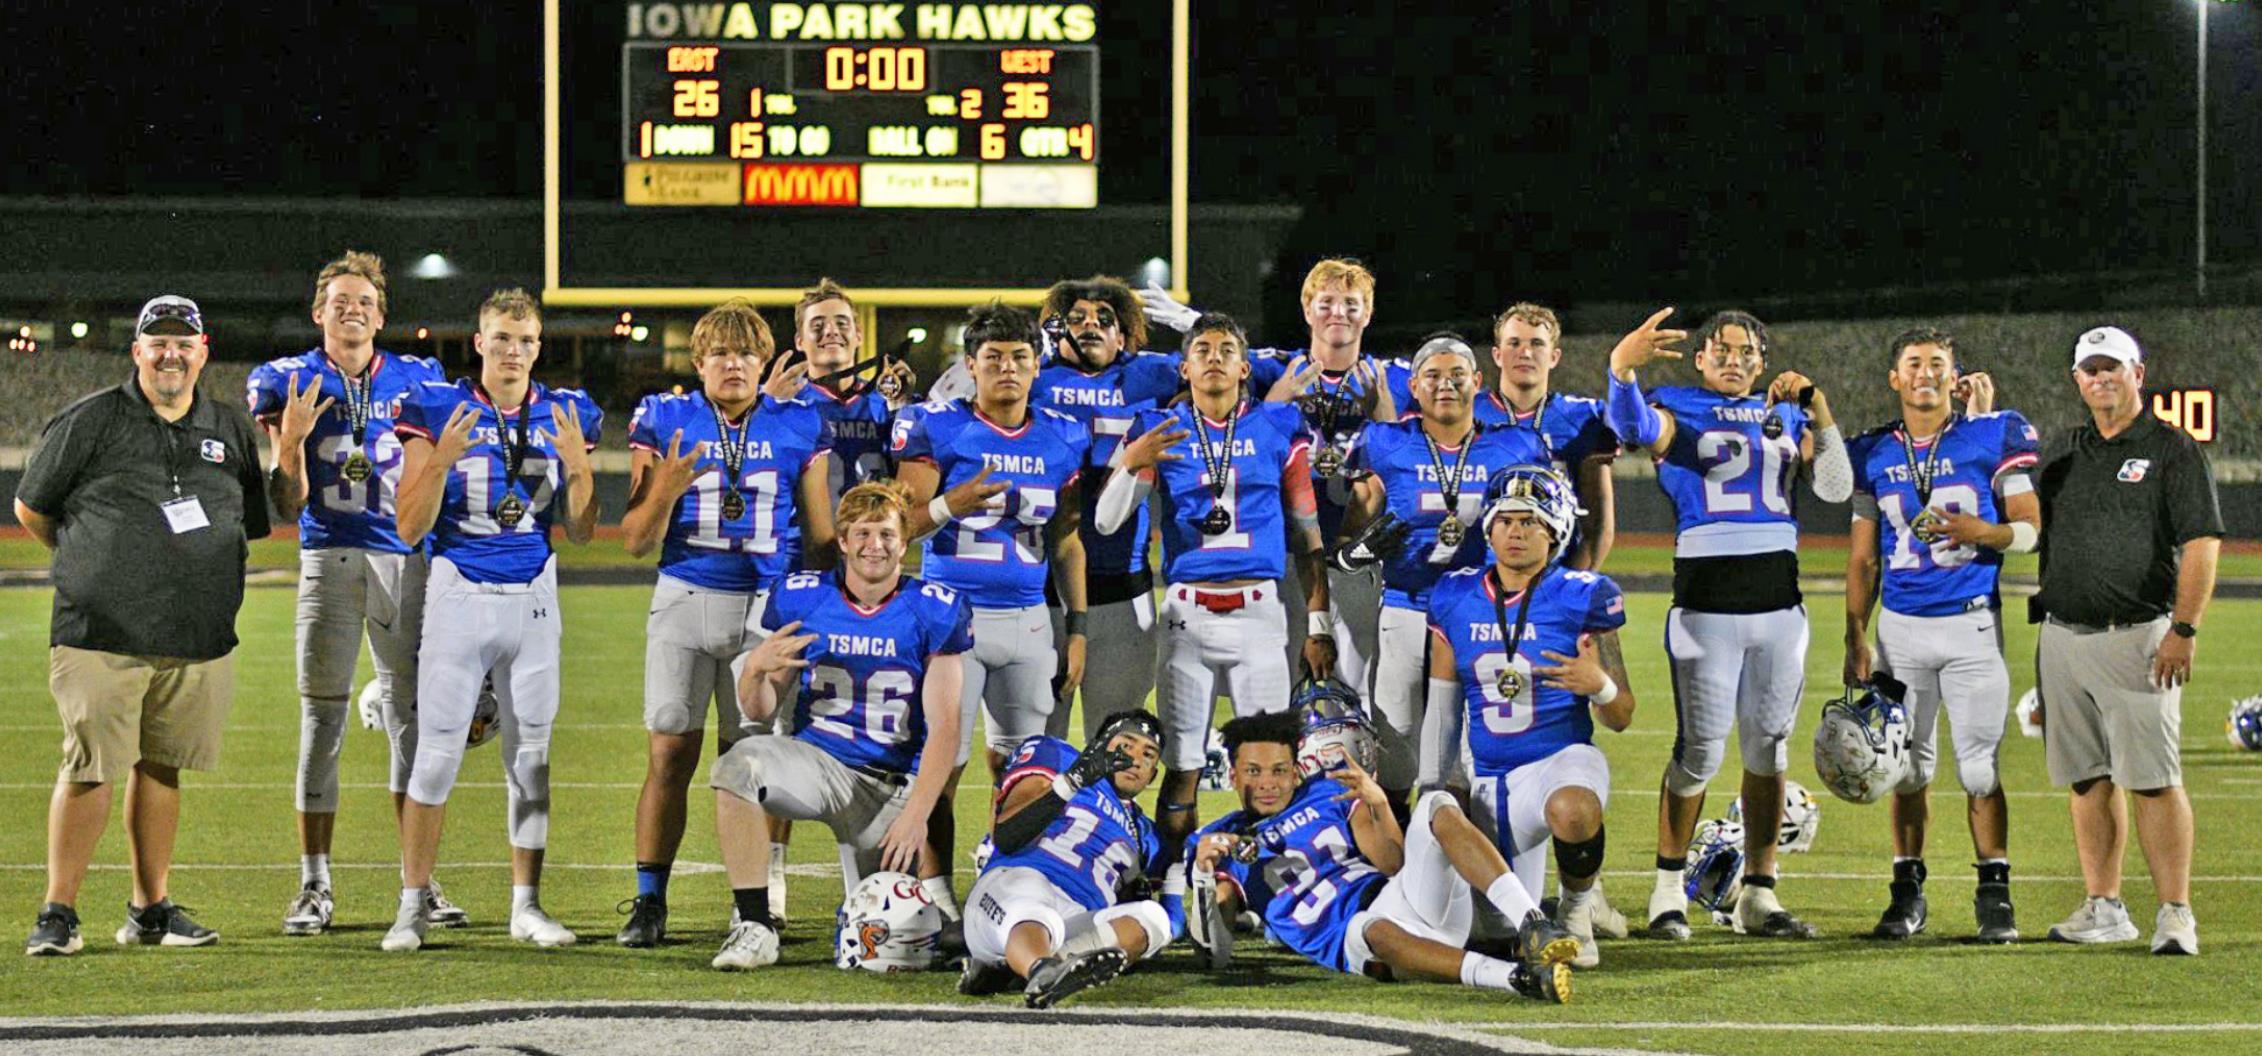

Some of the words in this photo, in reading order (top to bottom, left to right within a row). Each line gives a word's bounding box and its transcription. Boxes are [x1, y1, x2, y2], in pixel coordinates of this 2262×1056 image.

[627, 3, 758, 39] IOWA
[769, 3, 904, 40] PARK
[916, 4, 1096, 41] HAWKS
[826, 47, 925, 91] 0:00
[673, 80, 719, 117] 26
[960, 88, 982, 119] 2
[1002, 82, 1049, 119] 36
[730, 122, 763, 159] 15
[981, 123, 1006, 160] 6
[1069, 123, 1093, 160] 4
[1052, 386, 1125, 407] TSMCA
[1712, 405, 1771, 423] TSMC
[2153, 390, 2213, 442] 40
[981, 452, 1045, 475] TSMCA
[1696, 430, 1799, 516] 20
[455, 456, 559, 535] 17
[686, 470, 778, 554] 11
[1199, 467, 1250, 550] 1
[955, 486, 1057, 564] 25
[1420, 492, 1485, 564] 7
[828, 633, 897, 657] TSMCA
[809, 664, 915, 745] 26
[1472, 650, 1536, 735] 9
